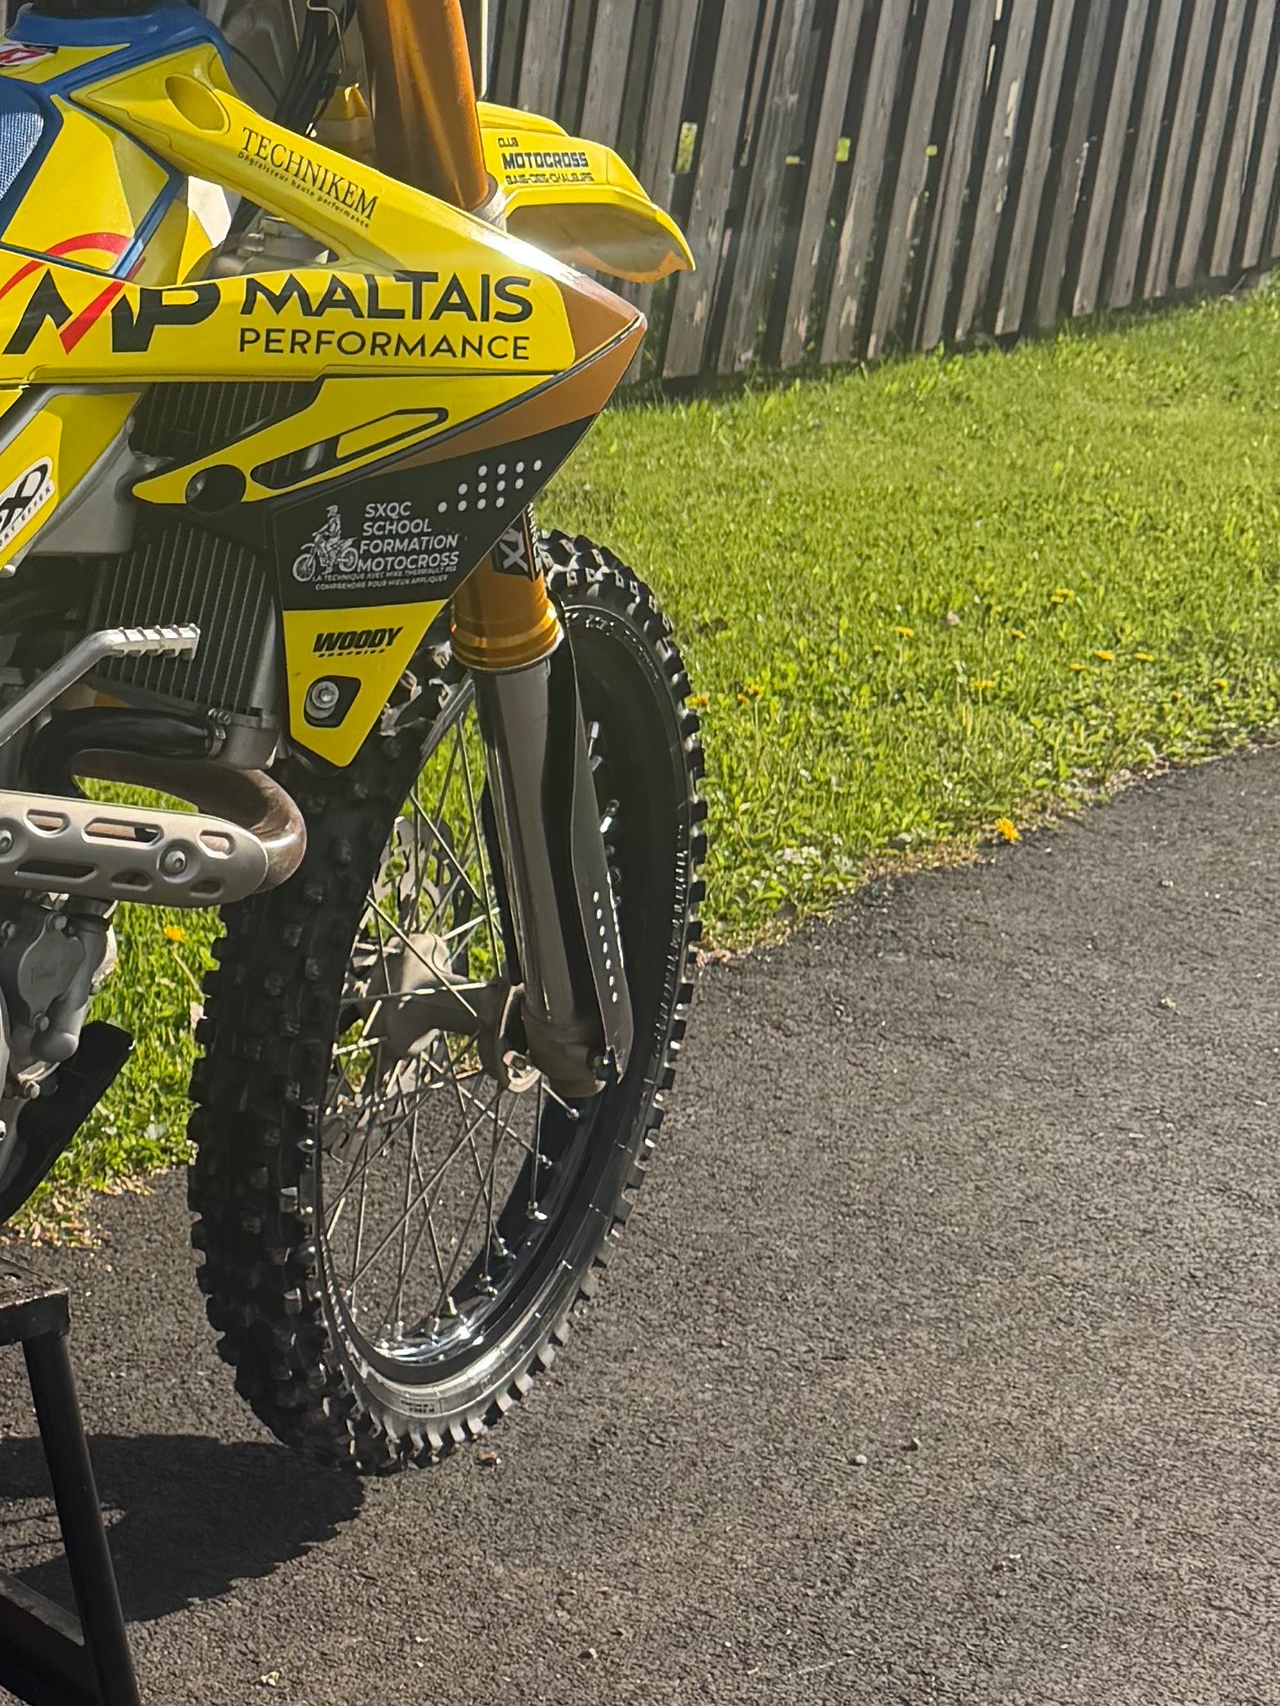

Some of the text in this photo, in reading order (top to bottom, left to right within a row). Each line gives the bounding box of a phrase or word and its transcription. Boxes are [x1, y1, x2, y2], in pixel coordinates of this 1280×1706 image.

[501, 152, 589, 170] MOTOCROSS
[242, 127, 379, 220] TECHNIKEM
[241, 270, 533, 323] MALTAIS
[239, 327, 530, 360] PERFORMANCE
[365, 501, 412, 519] SXQC
[362, 519, 432, 536] SCHOOL
[360, 534, 459, 554] FORMATION
[357, 551, 460, 572] MOTOCROSS
[313, 626, 404, 652] WOODY
